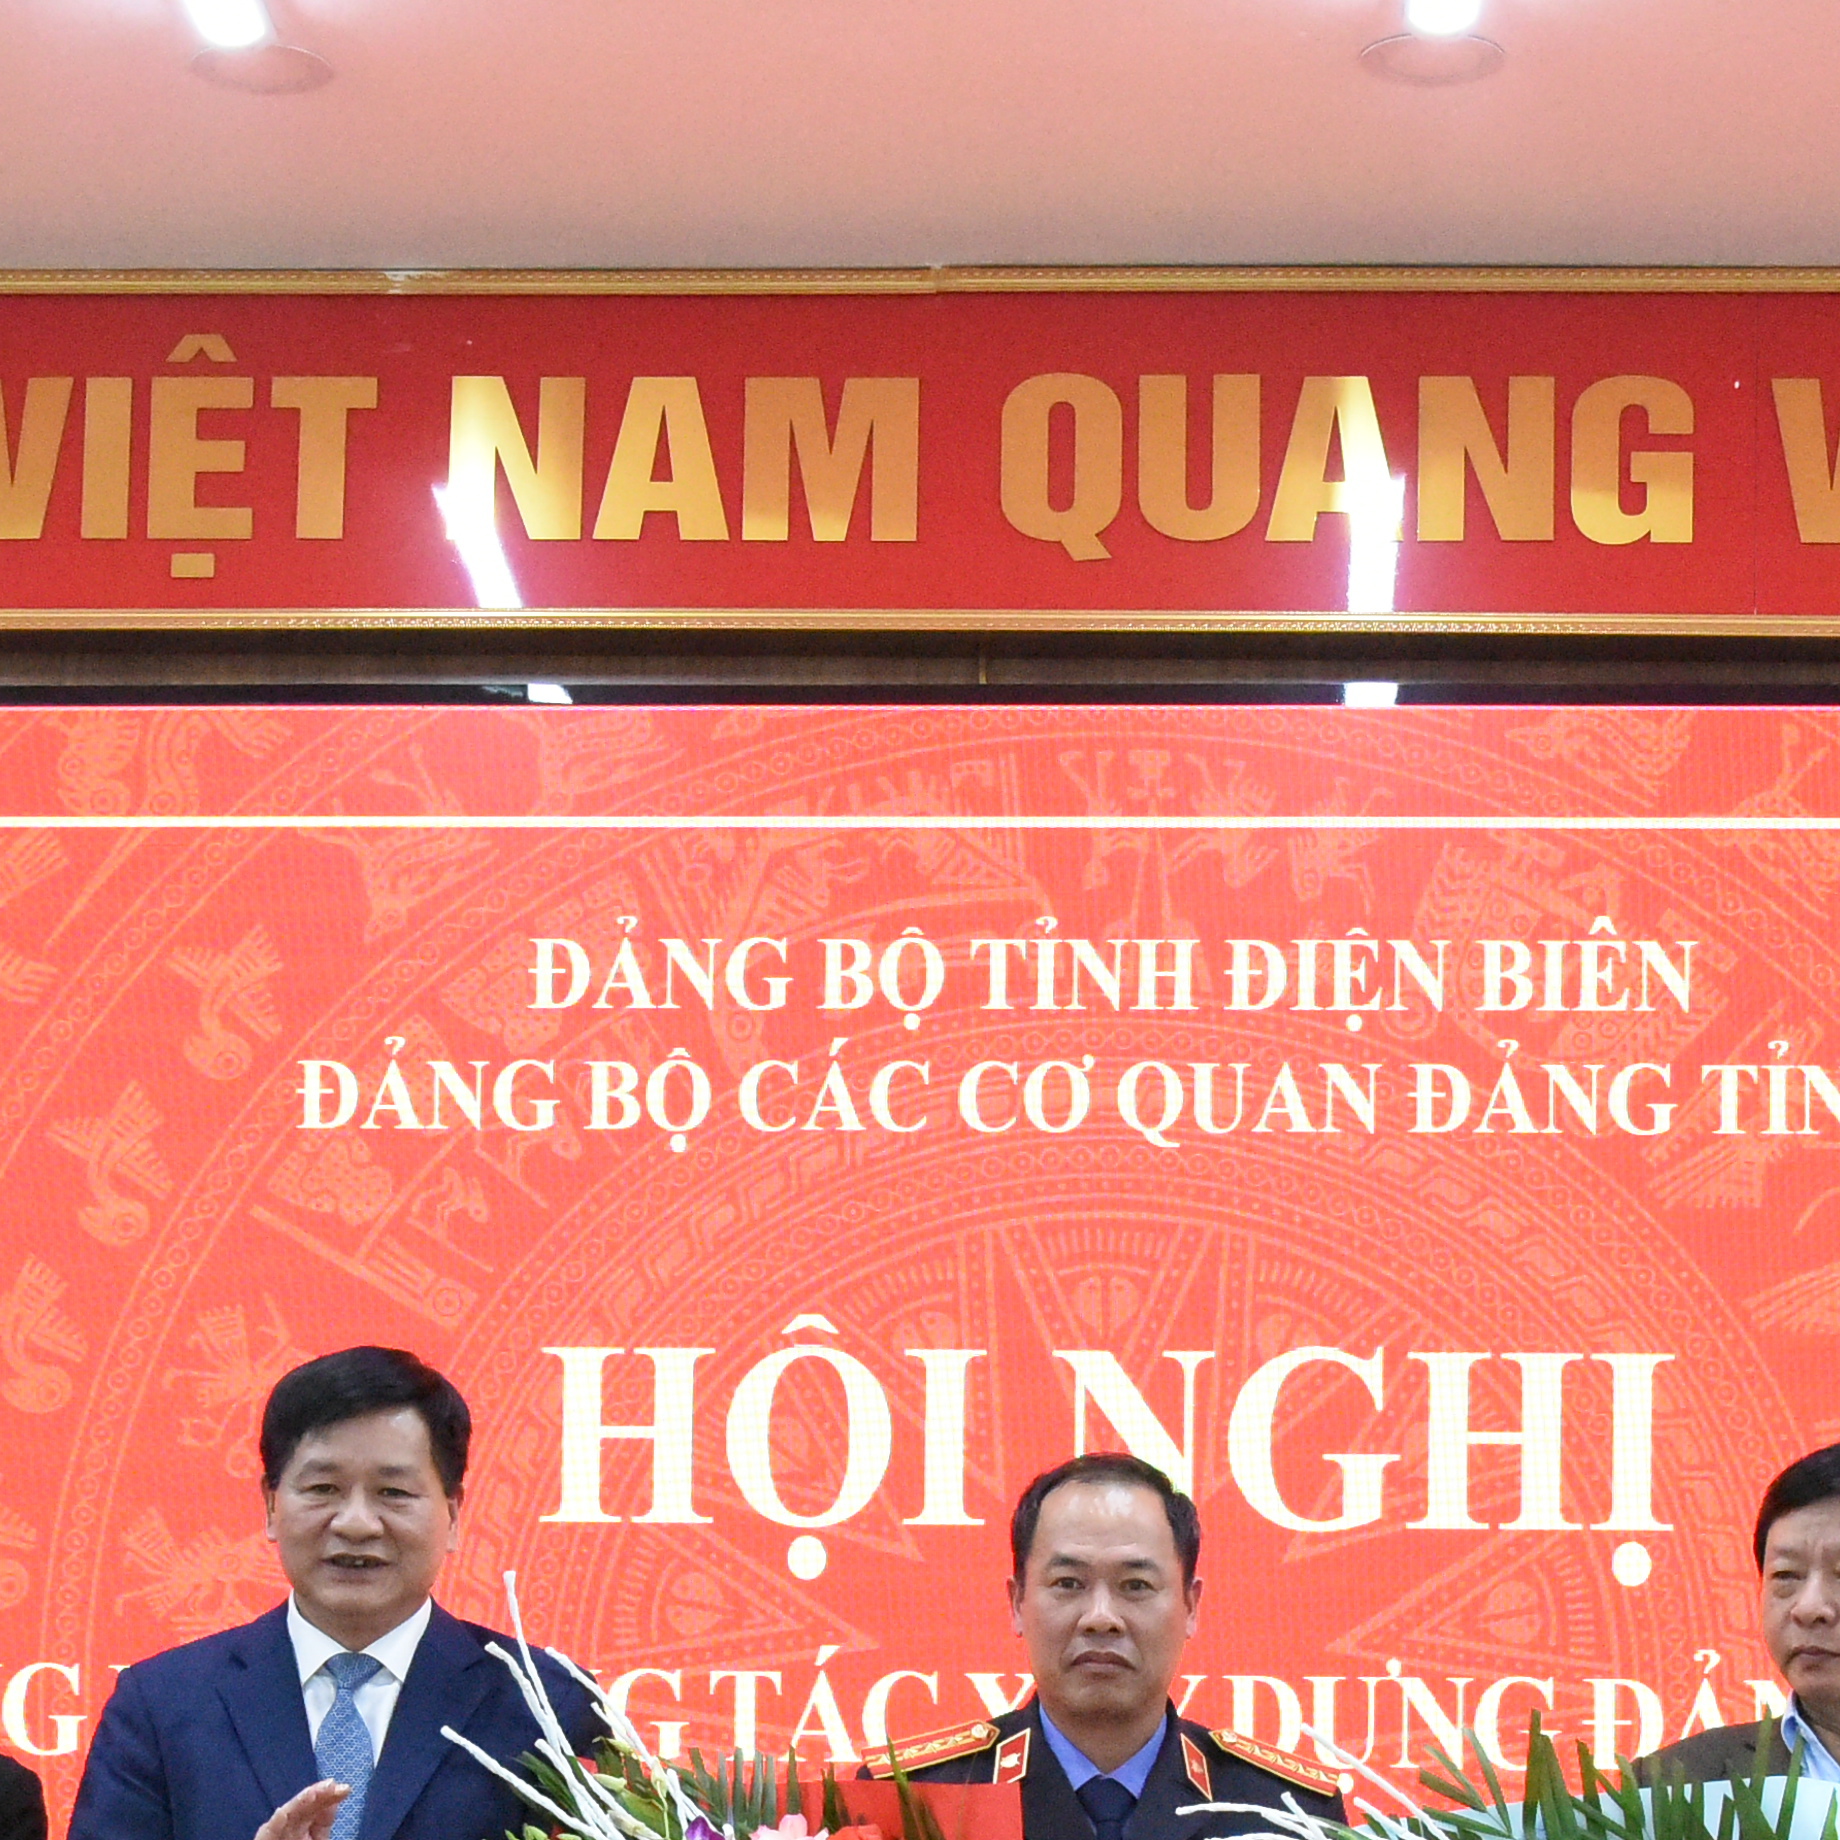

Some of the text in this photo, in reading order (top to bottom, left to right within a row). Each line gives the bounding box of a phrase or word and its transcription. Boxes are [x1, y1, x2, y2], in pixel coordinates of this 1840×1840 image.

[445, 376, 920, 542] NAM
[999, 372, 1695, 562] QUANG
[528, 915, 1697, 1026] ĐẢNG BỘ TỈNH ĐIỆN BIÊN
[296, 1036, 560, 1134] ĐẢNG
[585, 1047, 712, 1147] BỘ
[737, 1036, 930, 1133] CÁC
[959, 1054, 1094, 1134] CƠ
[1117, 1058, 1378, 1150] QUAN
[1407, 1039, 1677, 1137] ĐẢNG
[540, 1313, 1676, 1587] HỘI NGHỊ
[709, 1644, 939, 1764] TÁC
[1581, 1649, 1793, 1771] ĐẢ
